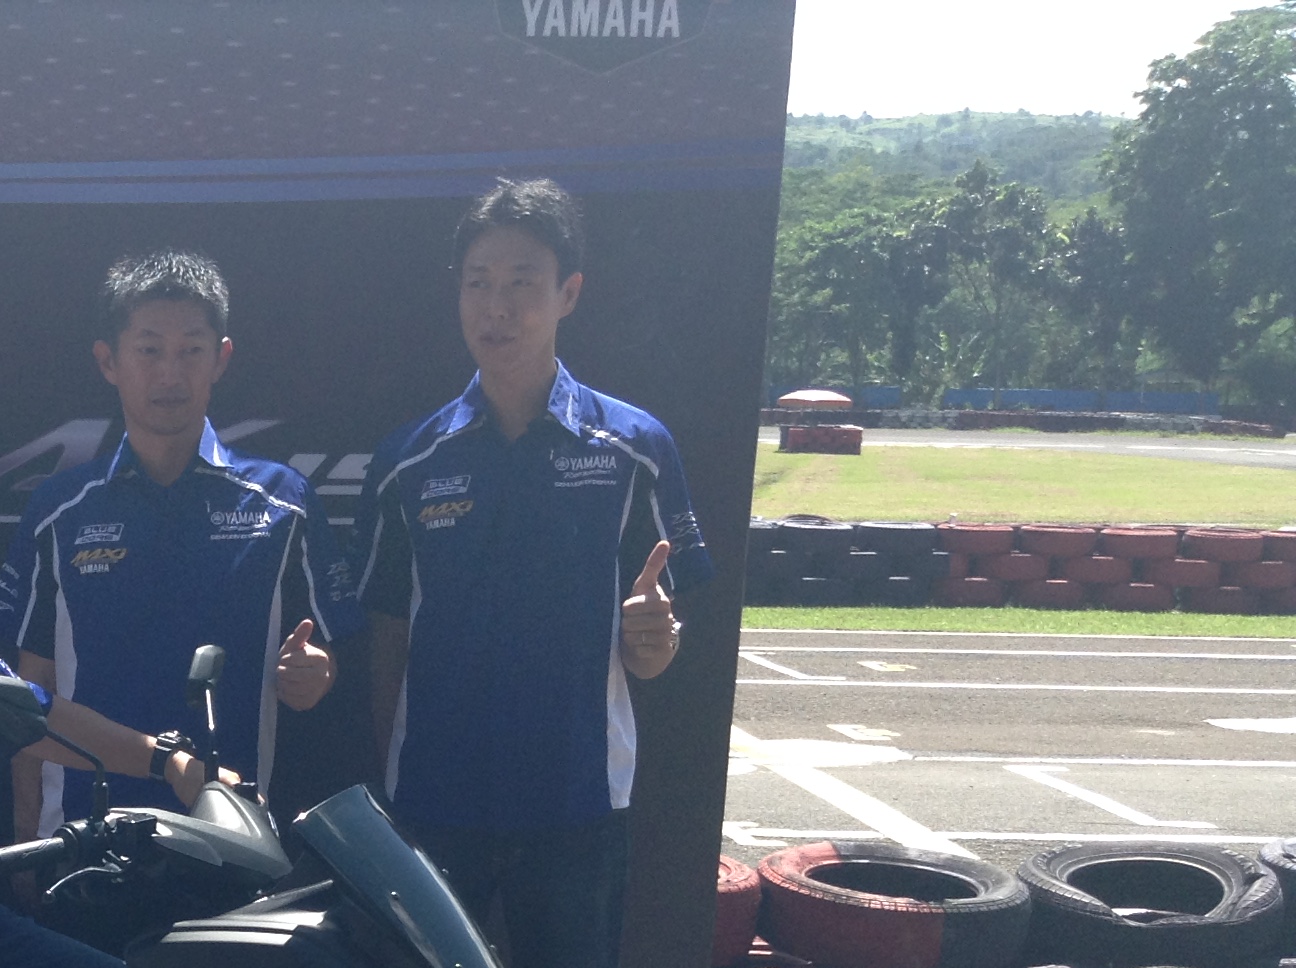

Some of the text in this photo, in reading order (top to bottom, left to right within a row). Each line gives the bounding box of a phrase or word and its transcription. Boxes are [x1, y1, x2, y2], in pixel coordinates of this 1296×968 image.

[521, 0, 681, 39] YAMAHA
[569, 454, 618, 471] YAMAHA
[224, 510, 271, 526] YAMAHA
[425, 516, 457, 531] YAMAHA
[79, 563, 111, 575] YAMAHA
